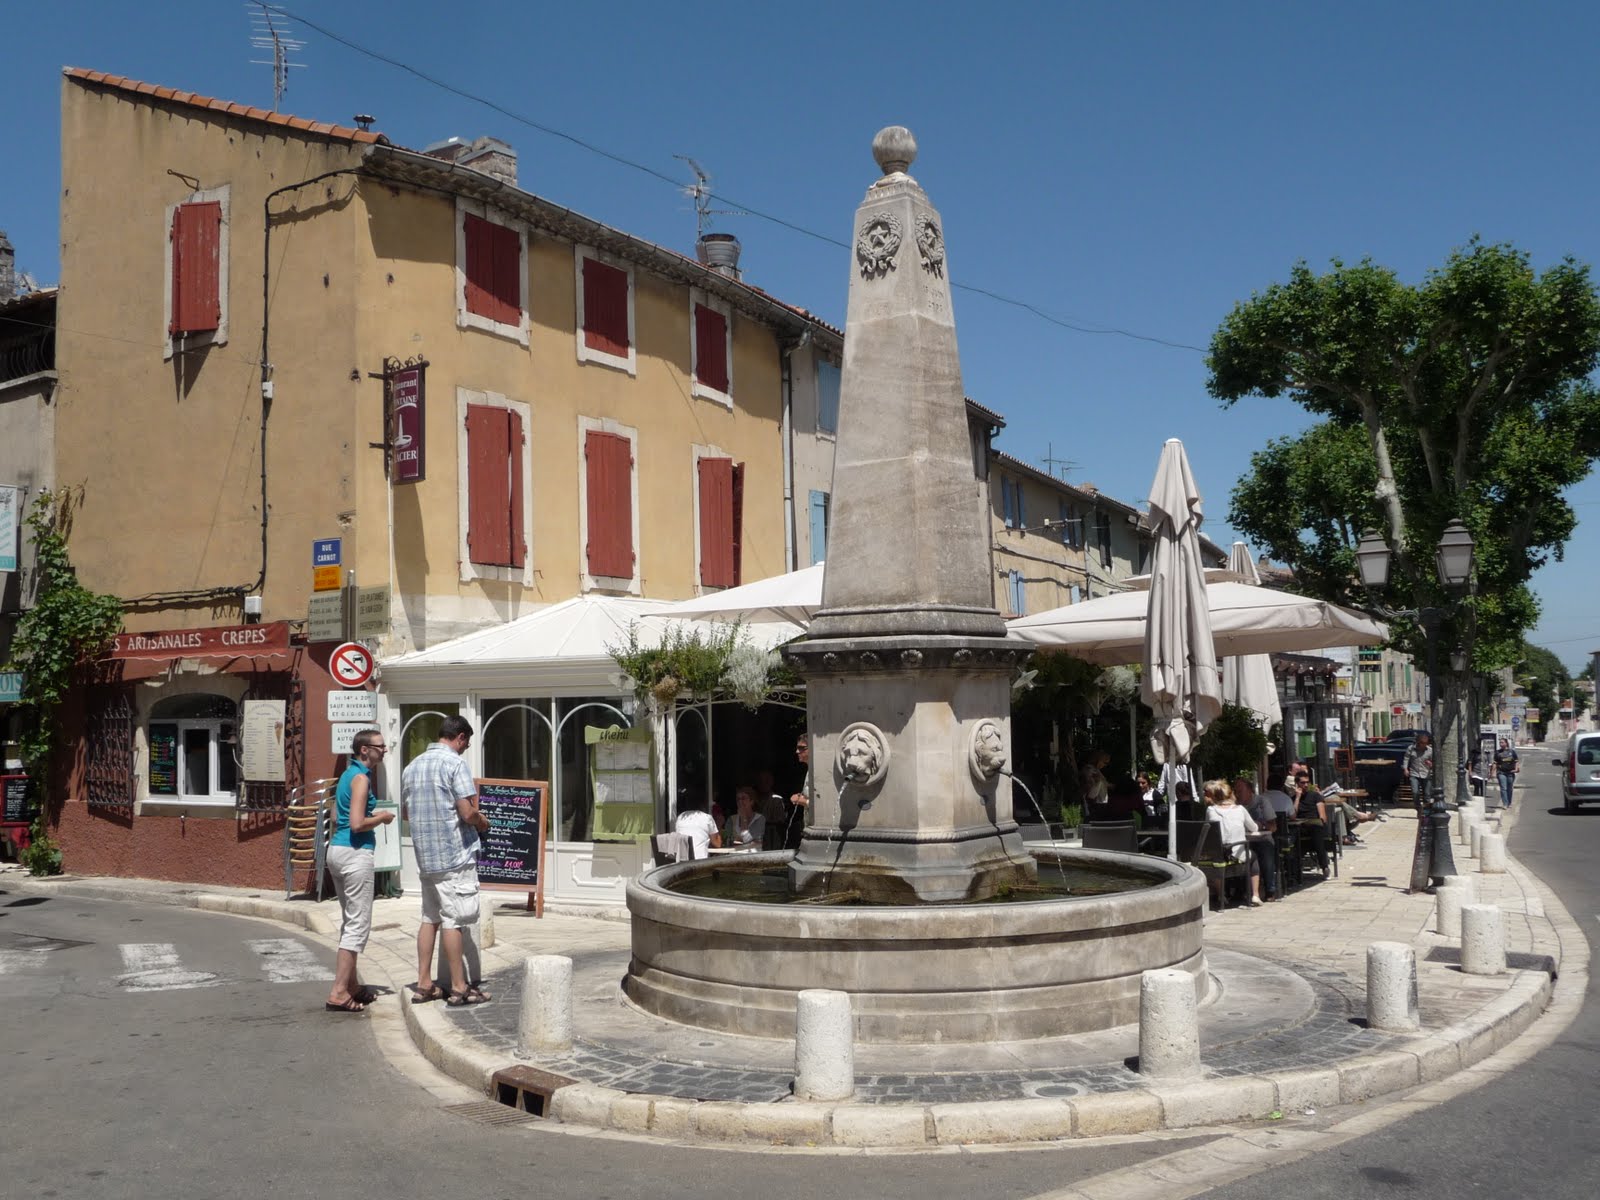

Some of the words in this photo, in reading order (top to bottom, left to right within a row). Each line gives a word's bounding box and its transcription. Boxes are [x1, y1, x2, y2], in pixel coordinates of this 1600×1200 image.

[317, 553, 336, 562] CARNOT
[128, 633, 201, 650] ARTISANALES
[221, 628, 266, 646] CREPES
